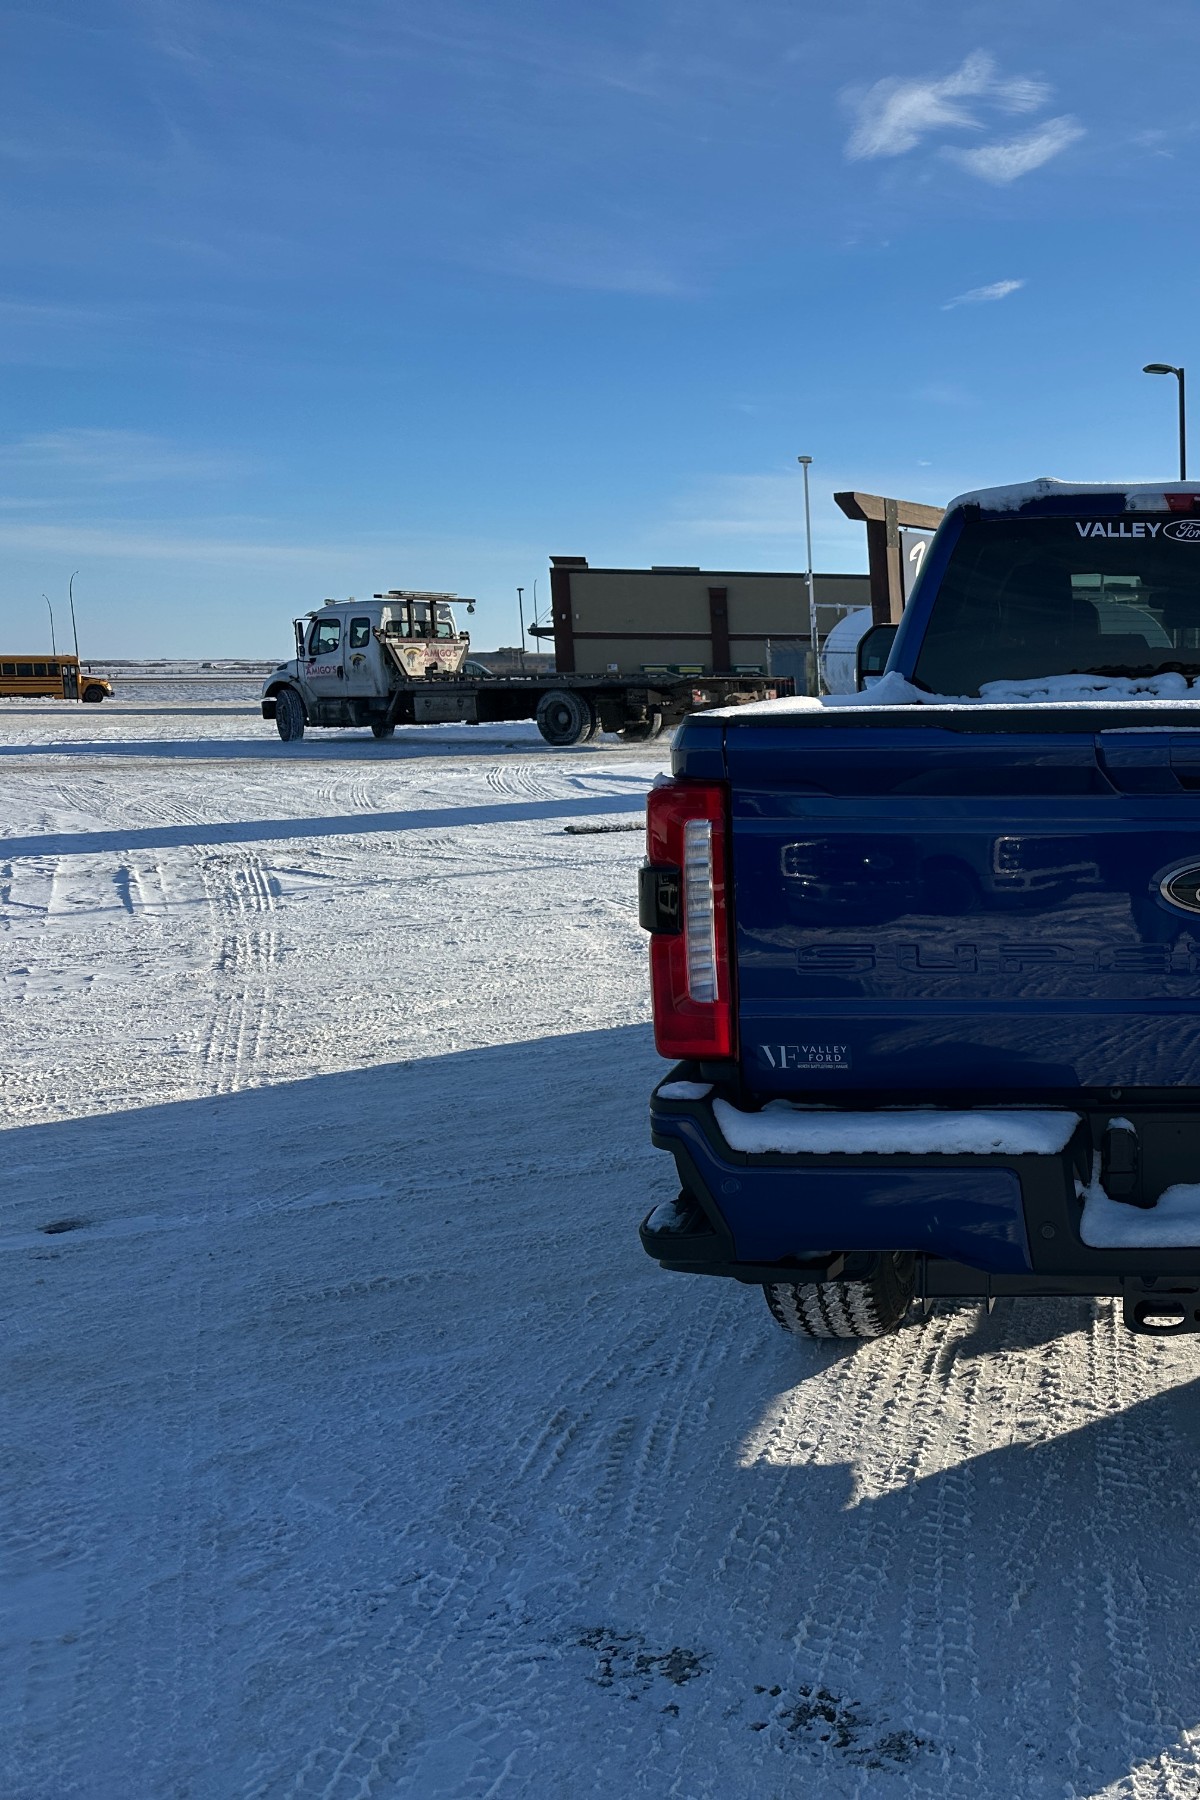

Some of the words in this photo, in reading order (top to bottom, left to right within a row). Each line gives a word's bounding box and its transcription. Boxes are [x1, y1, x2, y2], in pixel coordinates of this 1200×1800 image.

[1075, 522, 1161, 538] VALLEY
[802, 1045, 847, 1054] VALLEY
[809, 1054, 842, 1062] FORD
